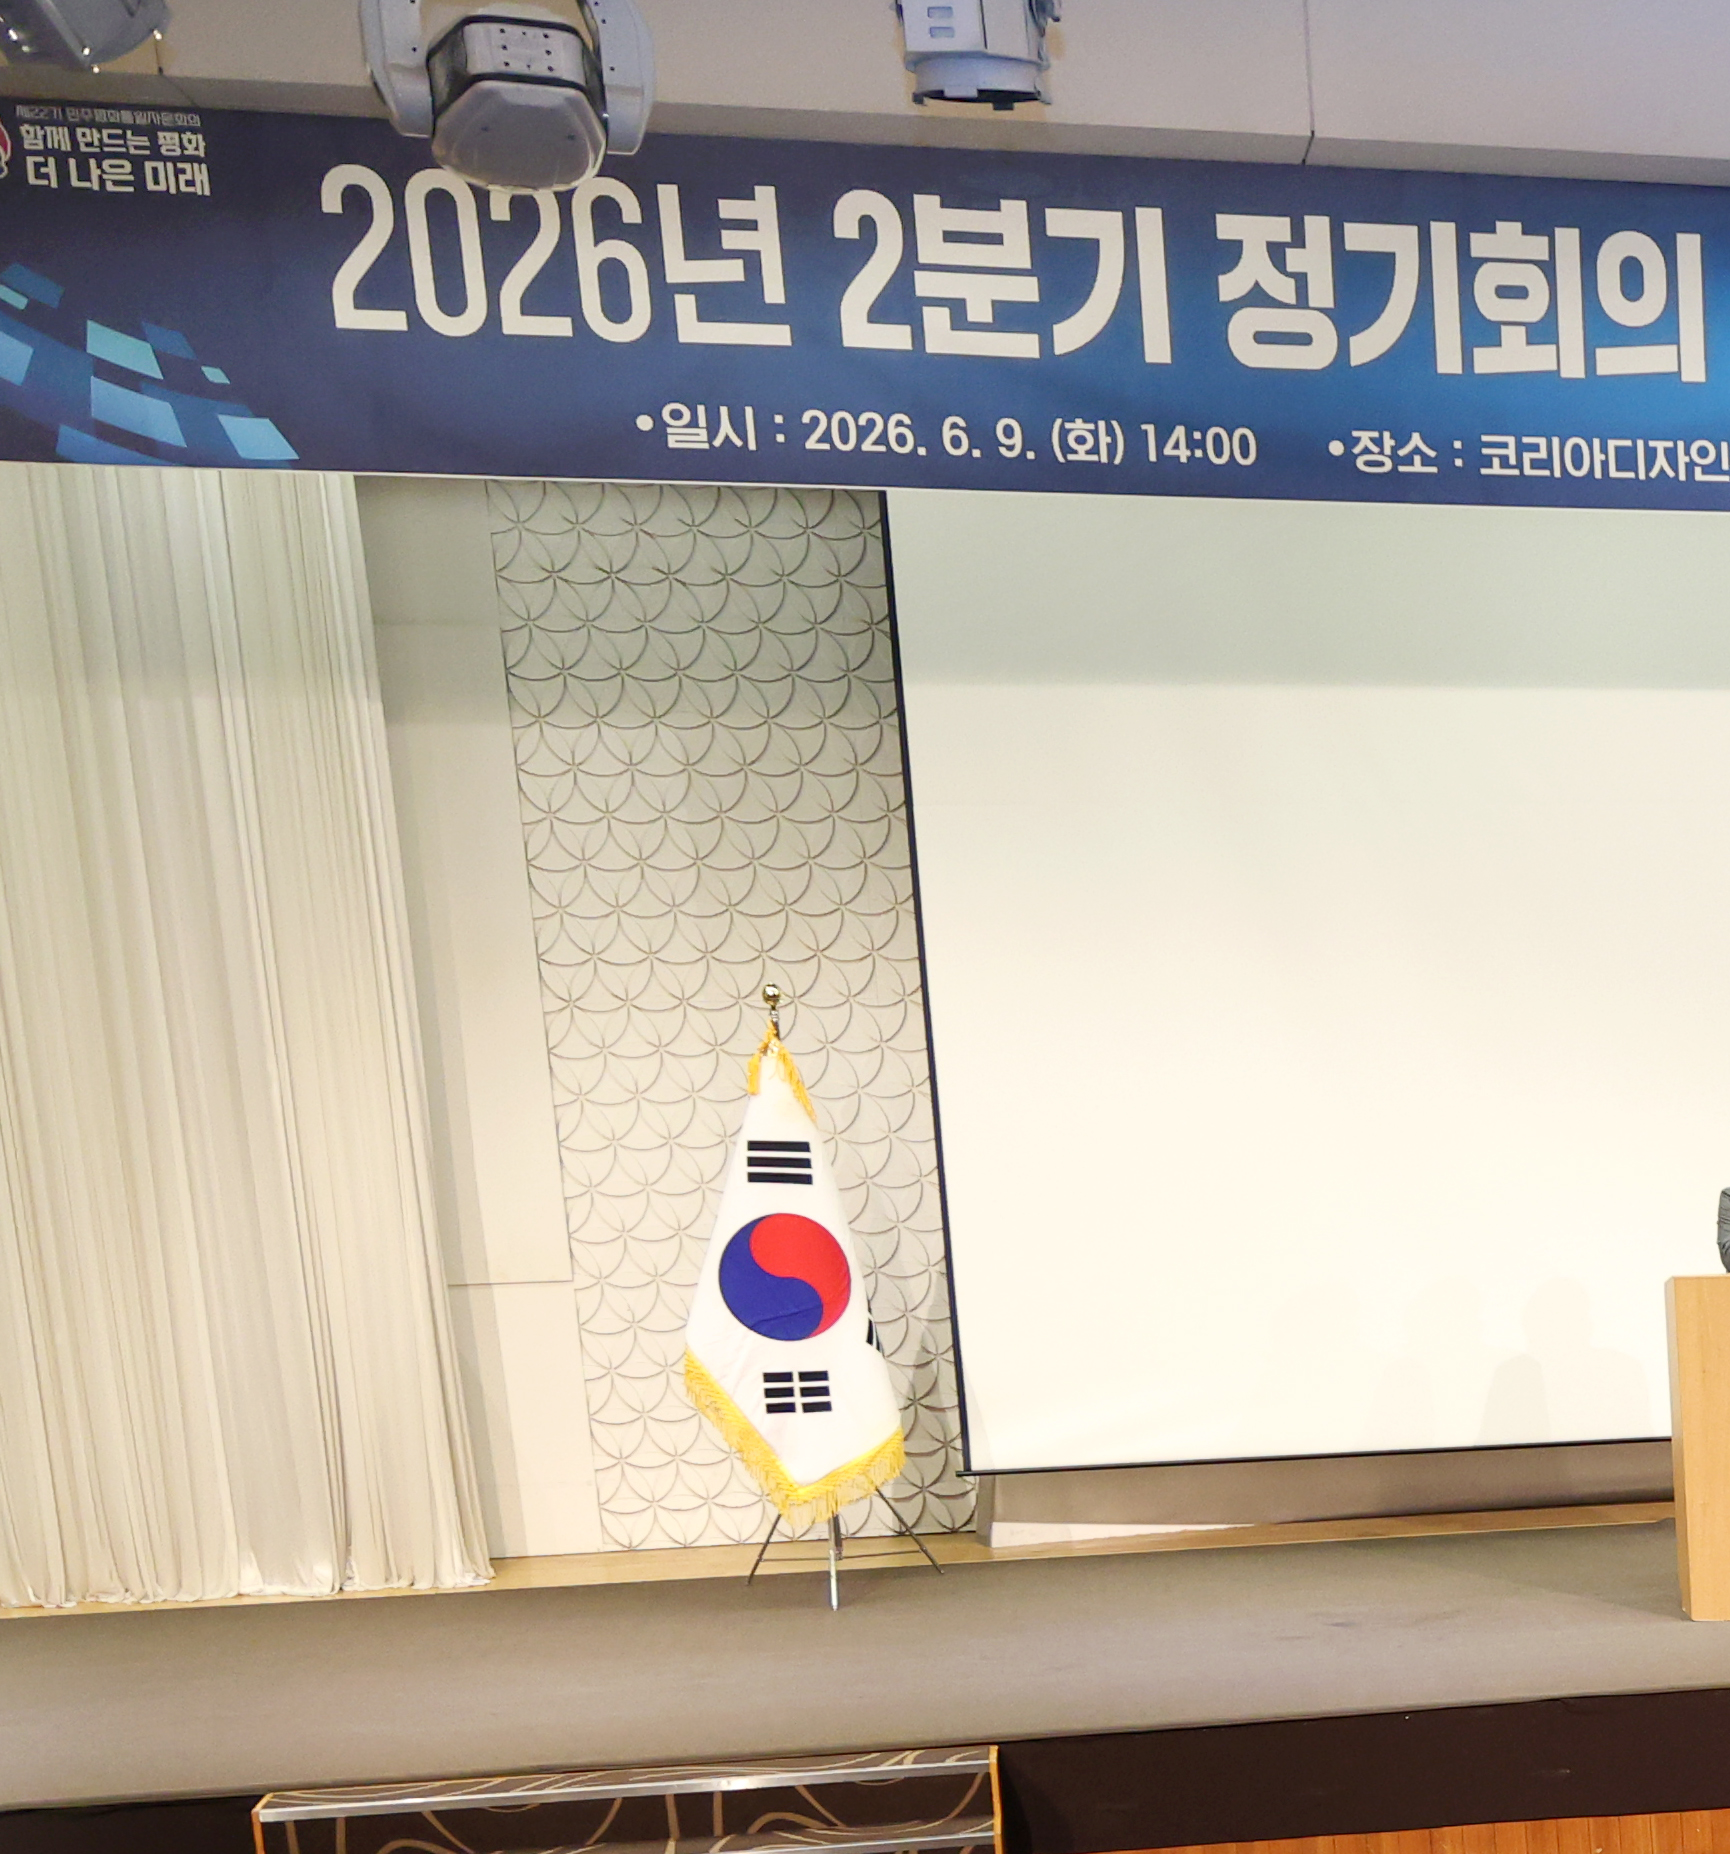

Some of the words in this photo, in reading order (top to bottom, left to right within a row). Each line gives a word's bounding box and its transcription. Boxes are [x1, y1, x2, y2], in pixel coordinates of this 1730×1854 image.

[20, 124, 71, 151] 함께
[76, 128, 150, 154] 만드는
[157, 132, 205, 157] 평화
[26, 156, 57, 188] 더
[68, 158, 134, 192] 나은
[145, 161, 210, 196] 미래
[322, 164, 792, 346] 2026년
[834, 190, 1171, 363] 2분기
[1216, 214, 1706, 382] 정기회의
[662, 403, 756, 450] 일시
[802, 410, 926, 455] 2026.
[943, 416, 981, 457] 6.
[996, 418, 1035, 459] 9.
[1052, 418, 1124, 464] (화)
[1141, 424, 1256, 465] 14:00
[1352, 431, 1438, 473] 장소
